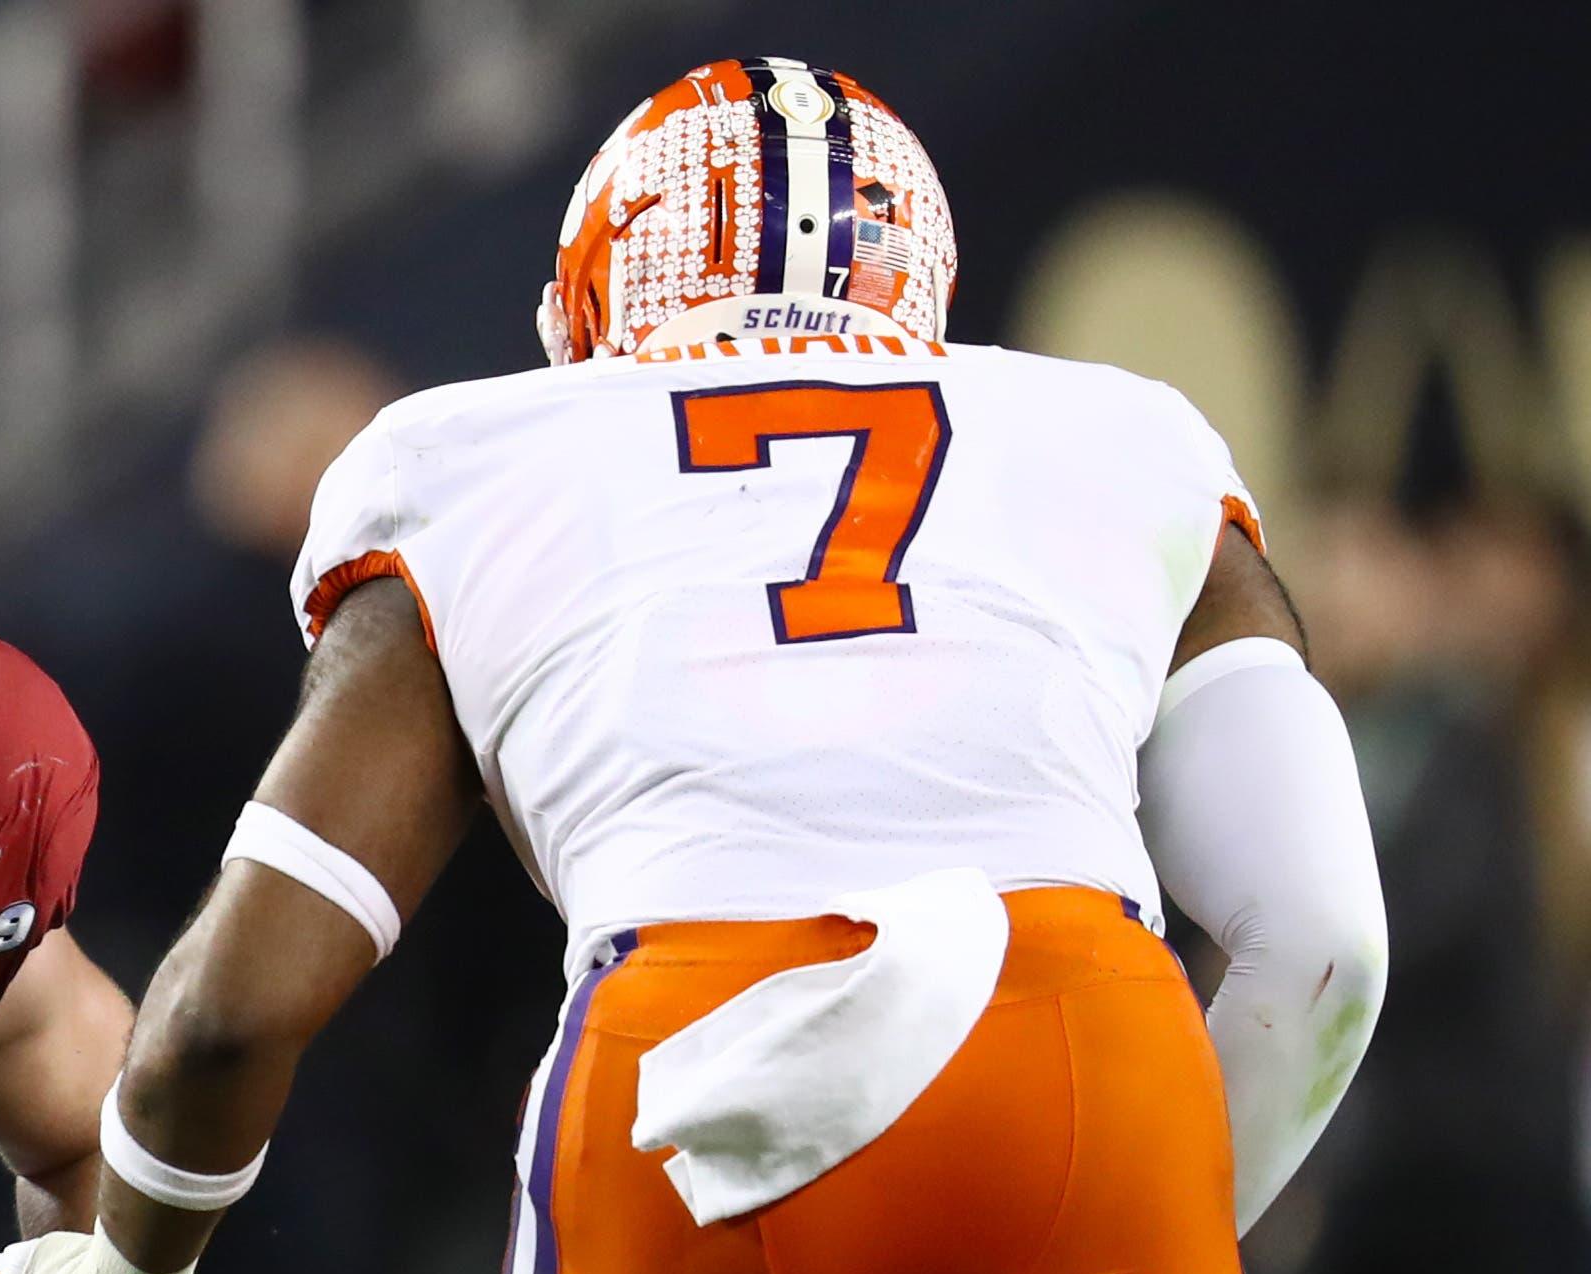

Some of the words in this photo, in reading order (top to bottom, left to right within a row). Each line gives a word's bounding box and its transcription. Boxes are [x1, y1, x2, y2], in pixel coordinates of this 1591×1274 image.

[829, 267, 850, 298] 7
[744, 303, 851, 334] schutt
[669, 379, 953, 645] 7
